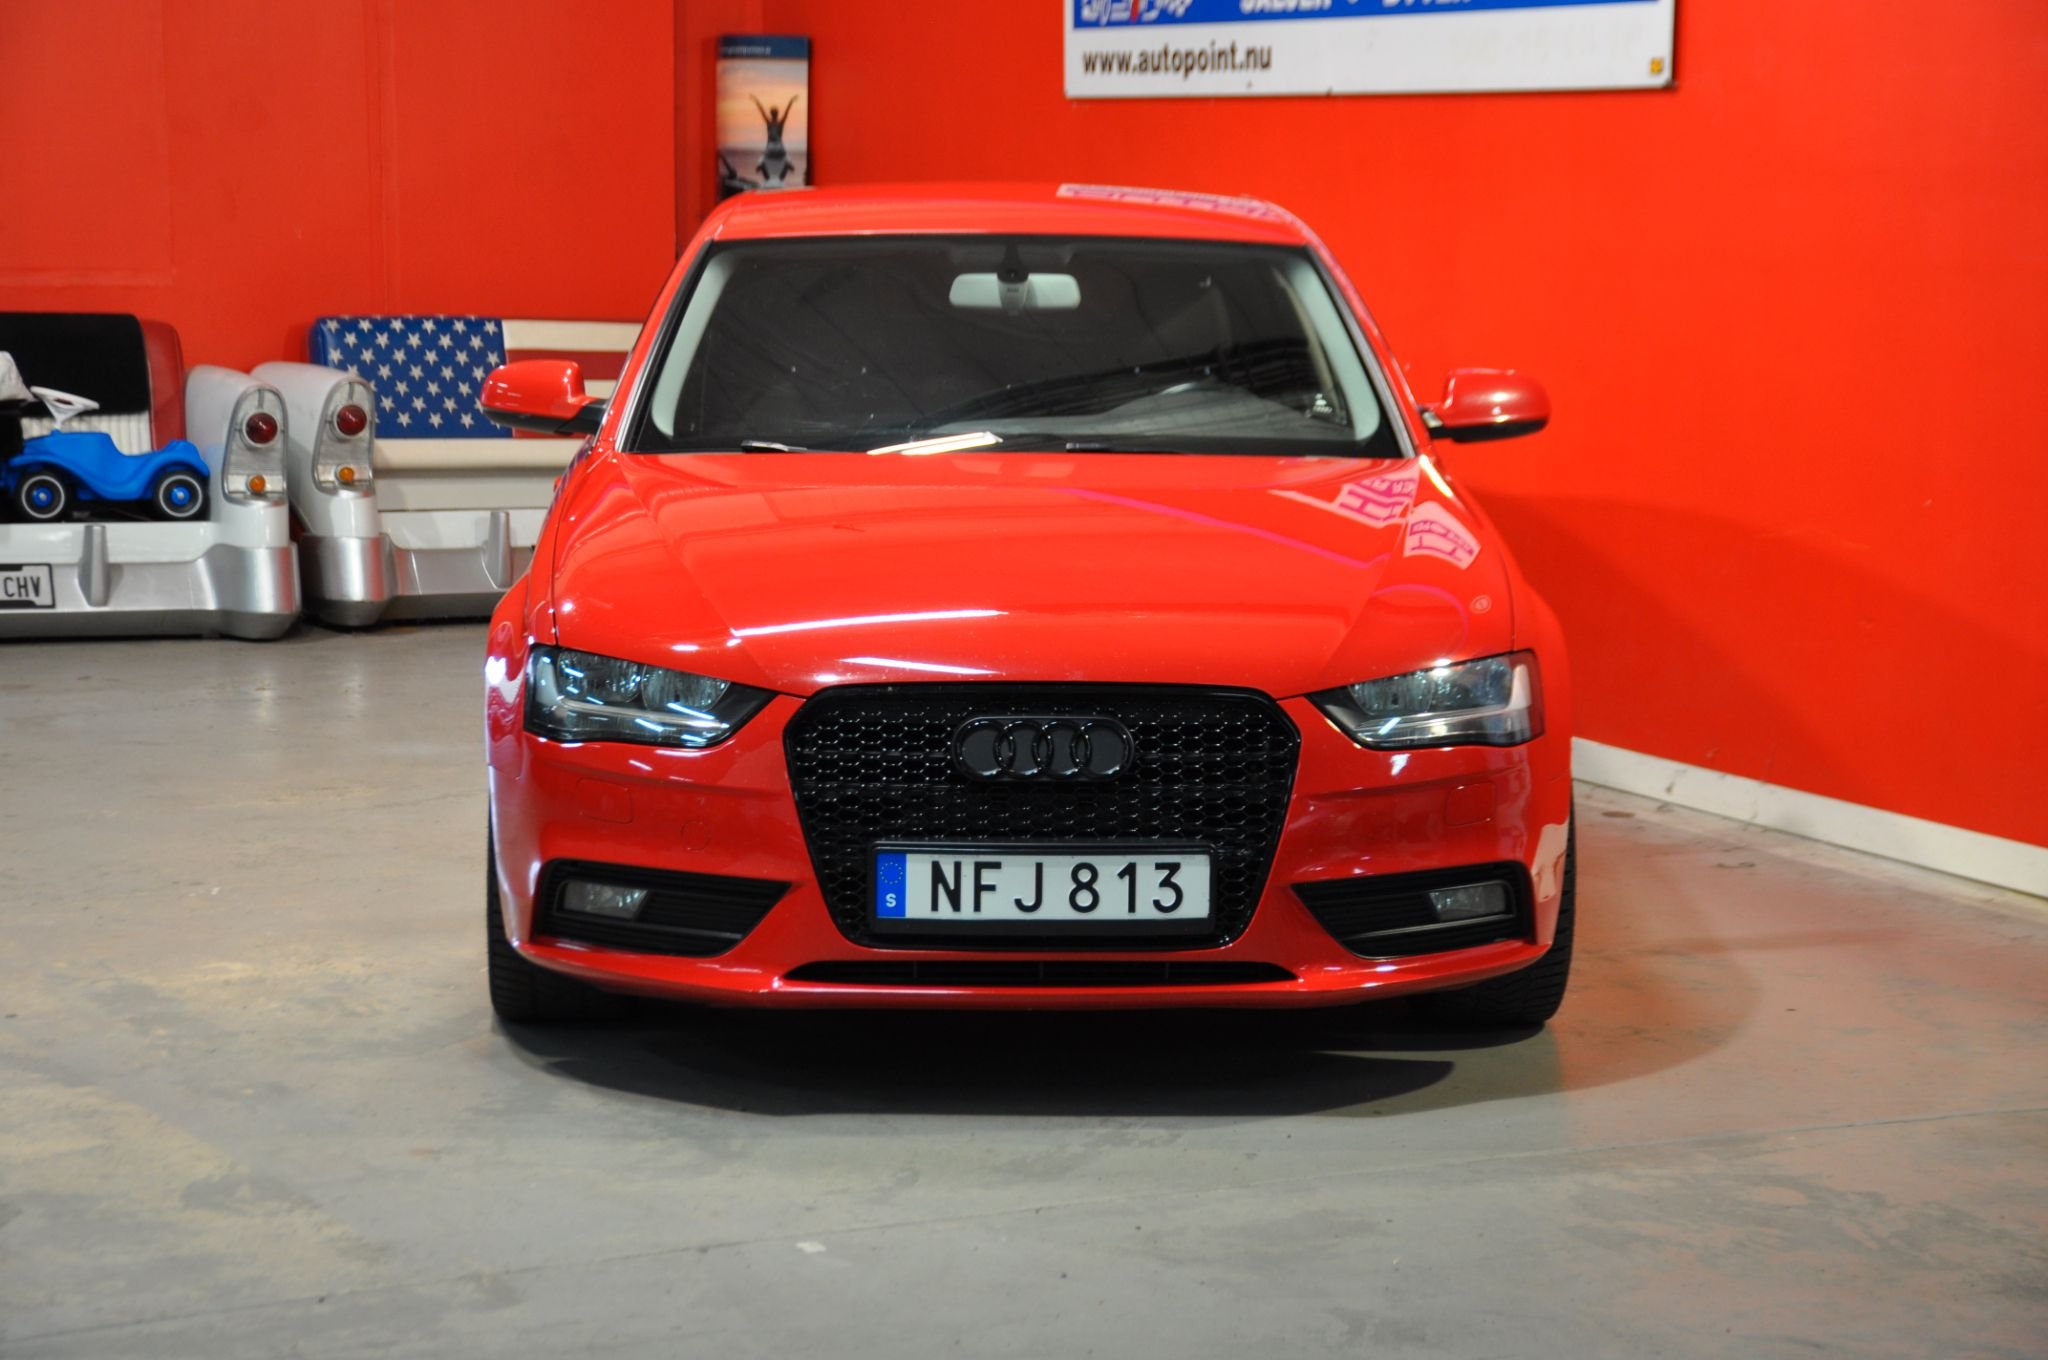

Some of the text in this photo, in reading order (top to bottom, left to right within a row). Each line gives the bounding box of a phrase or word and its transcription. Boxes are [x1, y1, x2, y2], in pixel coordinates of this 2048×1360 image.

[1083, 41, 1273, 79] www.autopoint.nu
[3, 575, 41, 598] CHV
[885, 892, 897, 908] S
[930, 860, 1184, 914] NFJ 813
